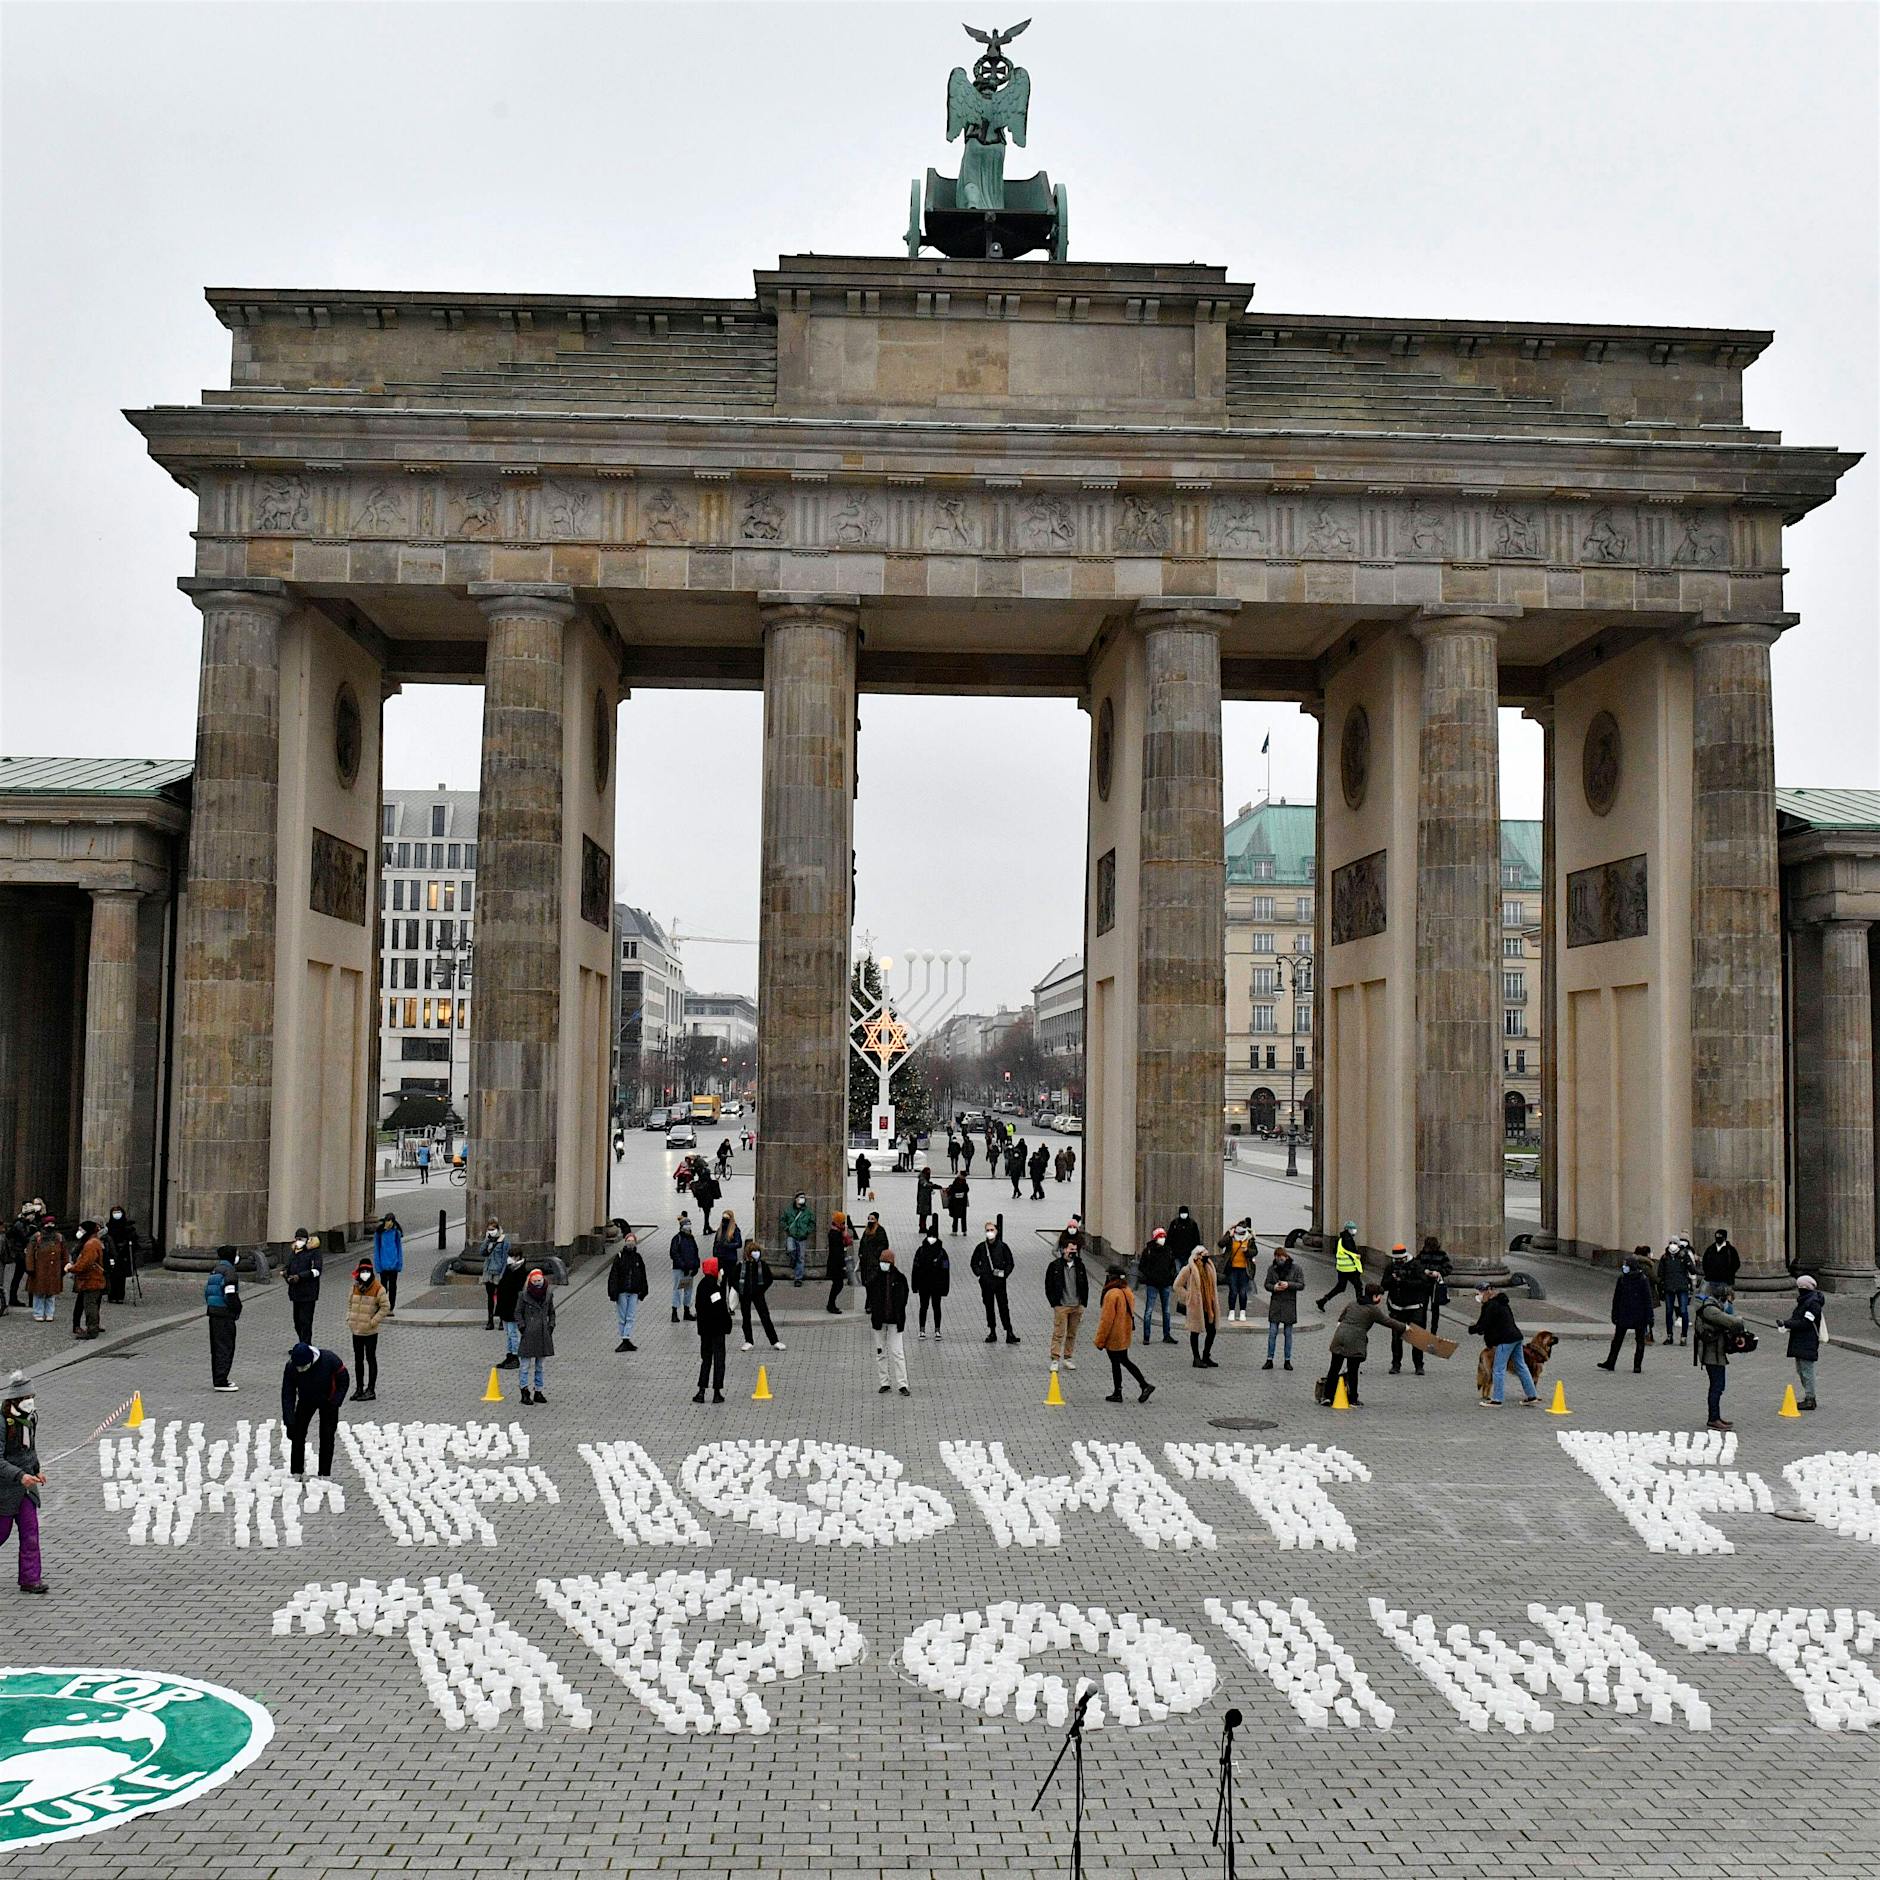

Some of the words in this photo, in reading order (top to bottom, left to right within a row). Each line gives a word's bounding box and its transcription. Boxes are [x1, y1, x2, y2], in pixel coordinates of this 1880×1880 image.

[98, 1418, 1373, 1551] #FIGHT
[56, 1674, 204, 1713] FOR
[0, 1764, 208, 1826] URE
